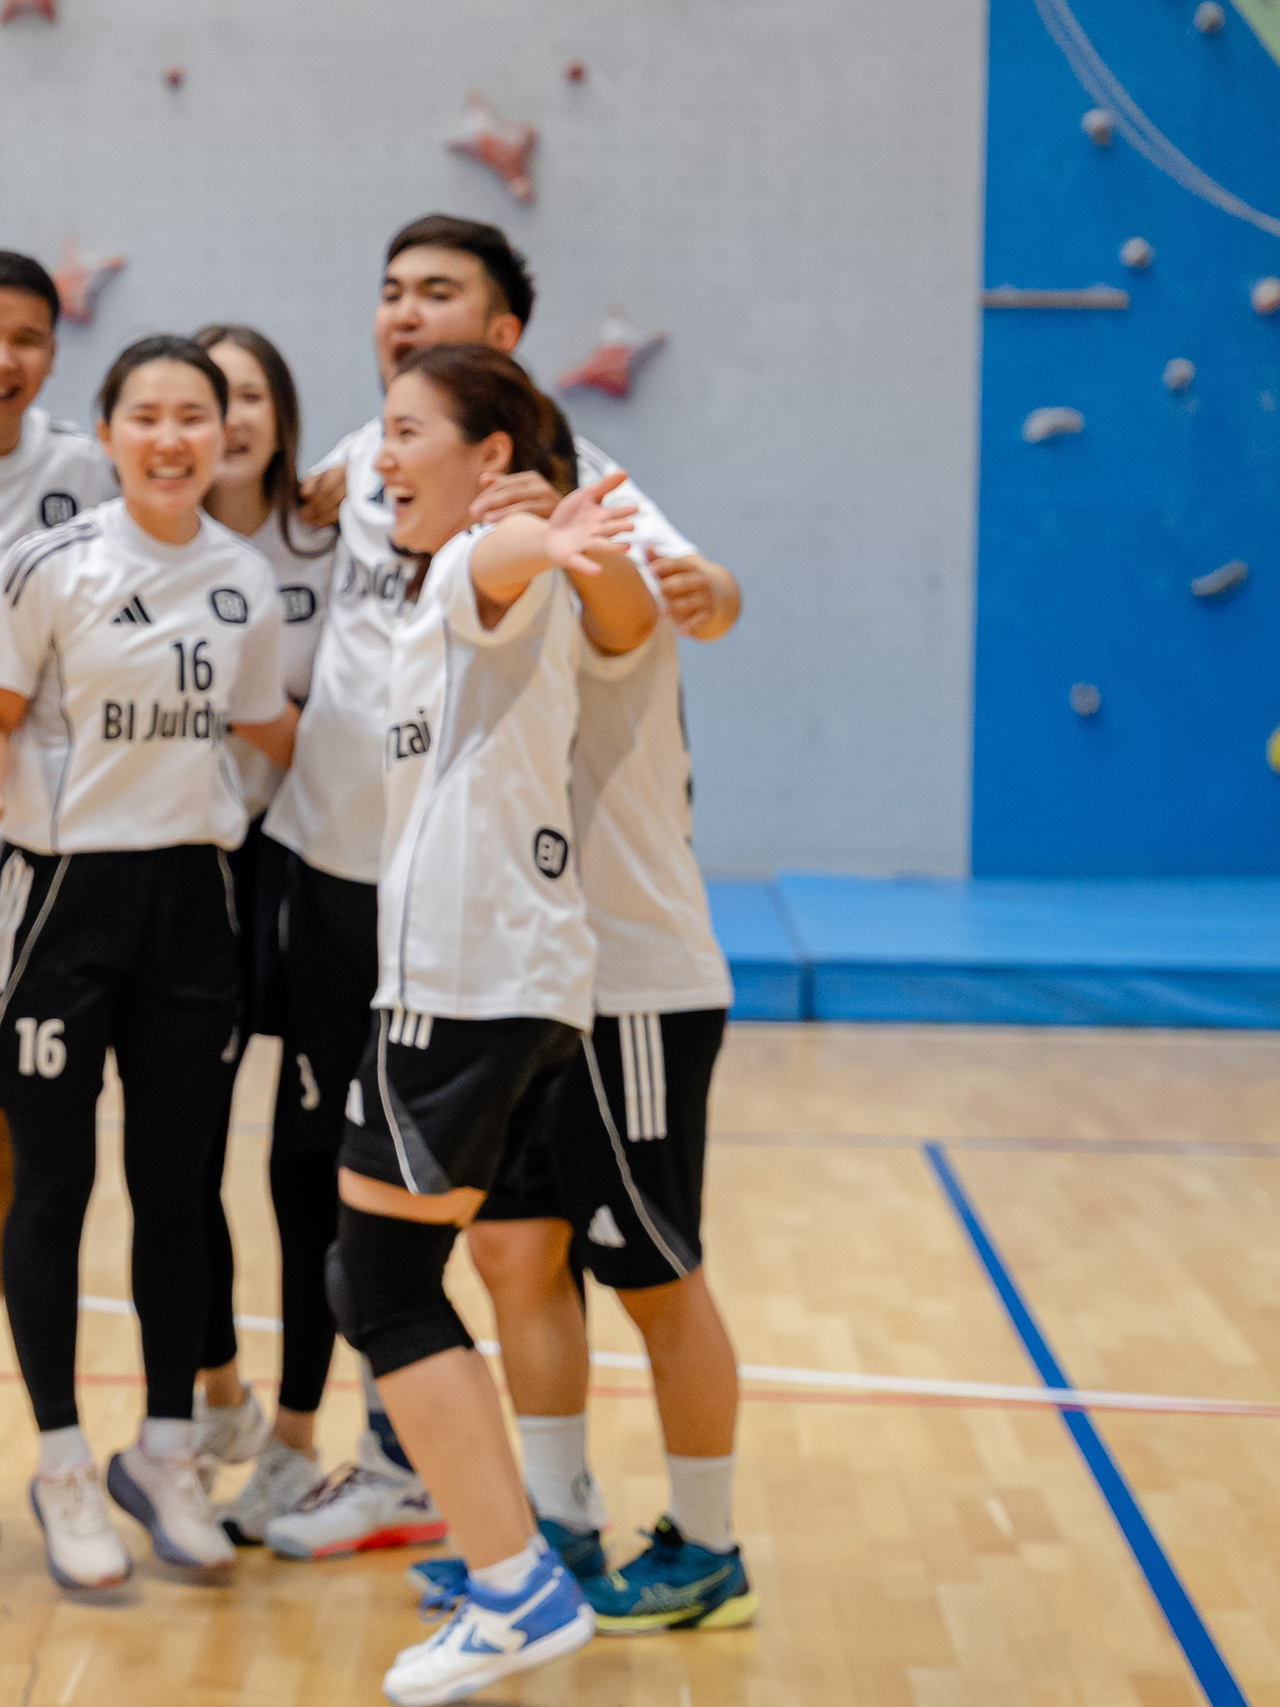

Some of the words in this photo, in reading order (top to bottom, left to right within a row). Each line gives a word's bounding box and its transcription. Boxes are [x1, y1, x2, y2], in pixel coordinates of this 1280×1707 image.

[173, 640, 214, 692] 16
[104, 702, 134, 741] BI
[15, 1017, 67, 1080] 16
